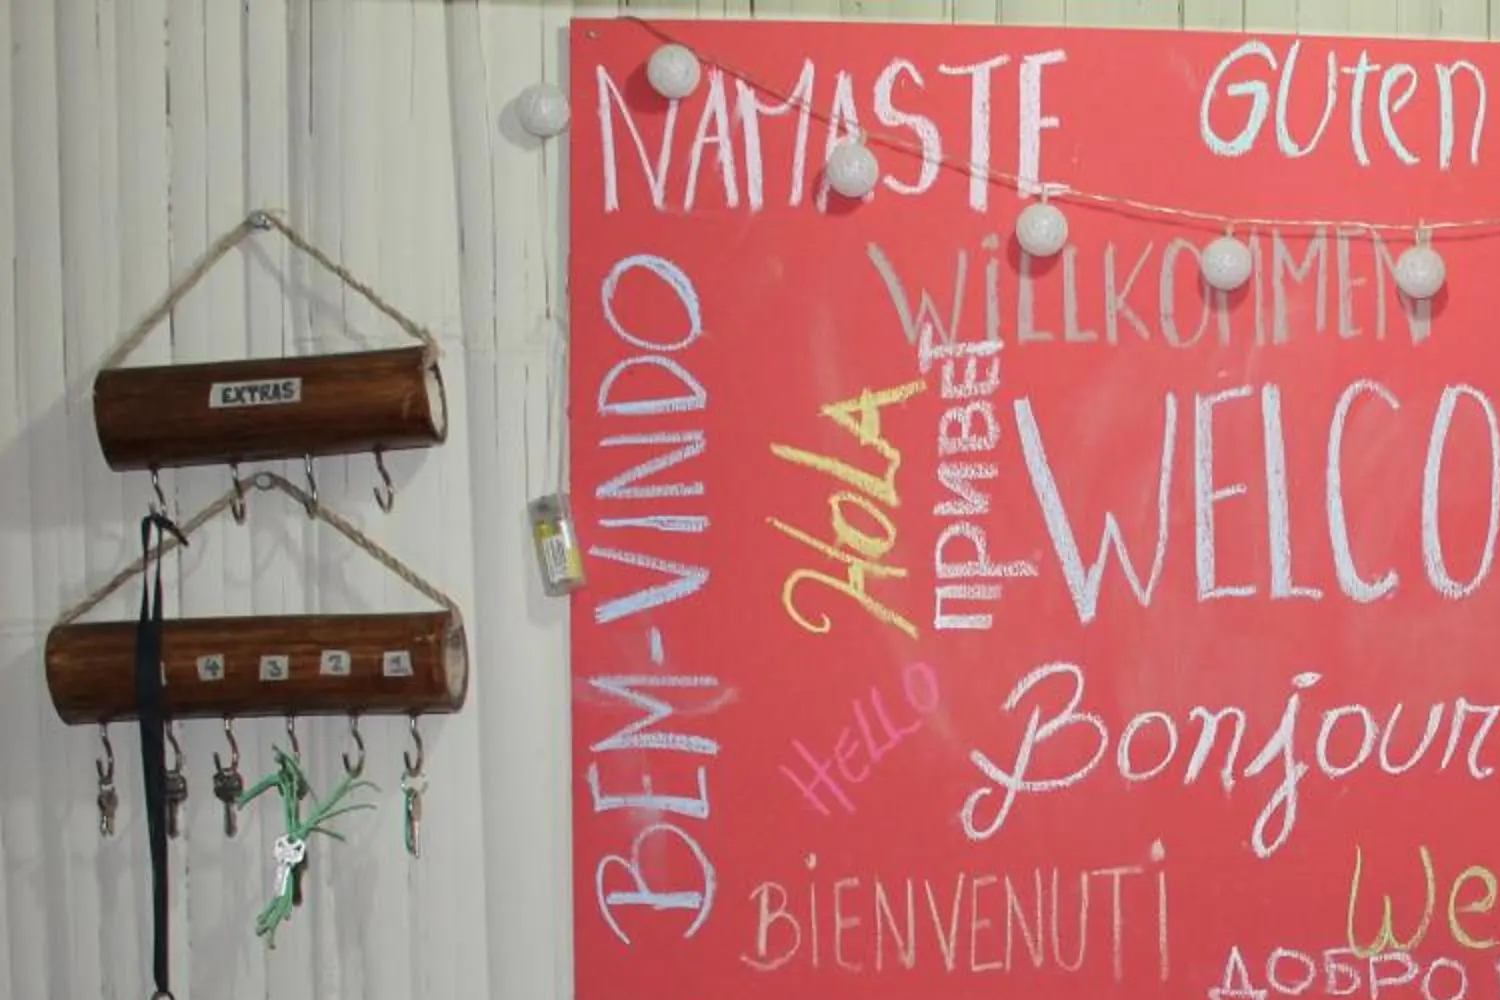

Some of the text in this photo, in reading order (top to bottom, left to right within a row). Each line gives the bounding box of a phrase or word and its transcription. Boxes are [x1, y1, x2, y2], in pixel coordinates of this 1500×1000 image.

[597, 50, 1069, 213] NAMASTE
[221, 381, 296, 405] EXTRAS
[917, 322, 1040, 630] ПРИВЕТ
[266, 660, 283, 678] 3
[327, 654, 344, 673] 2
[588, 253, 719, 945] BEM-VINDO
